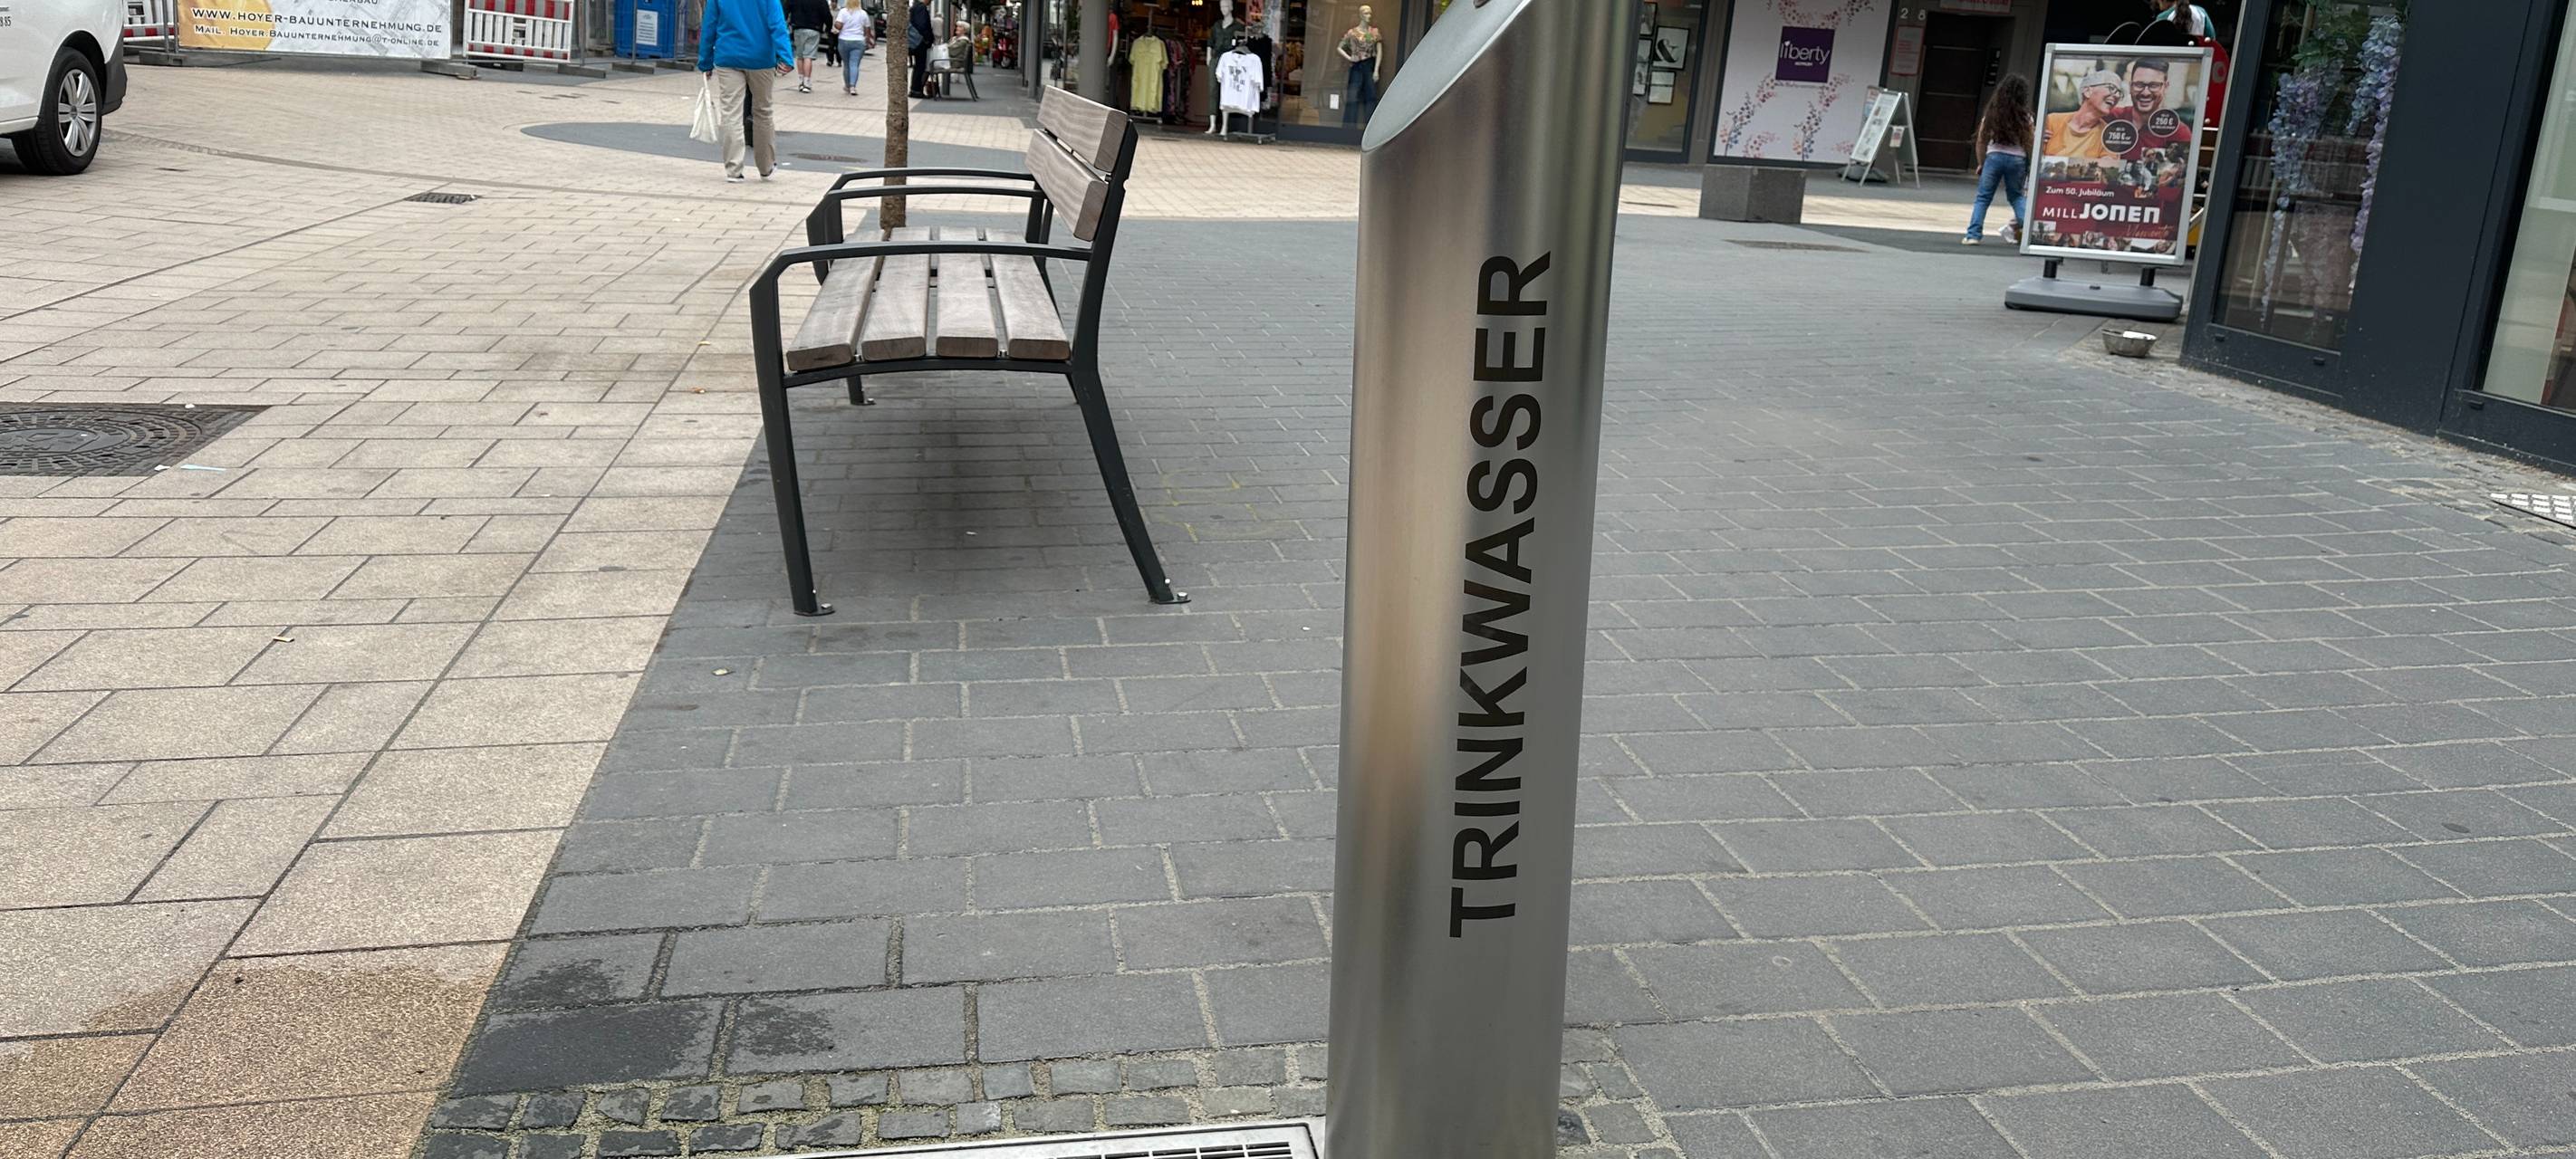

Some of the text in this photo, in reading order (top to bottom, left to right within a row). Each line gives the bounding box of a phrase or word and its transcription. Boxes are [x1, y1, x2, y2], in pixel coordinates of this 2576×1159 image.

[192, 8, 442, 33] WWW.HOYER-BAUUNTERNEHMUNG.DE
[1780, 41, 1831, 65] liberty
[2045, 186, 2064, 195] Zum
[2078, 188, 2114, 197] Jubiläum
[1449, 250, 1552, 939] TRINKWASSER
